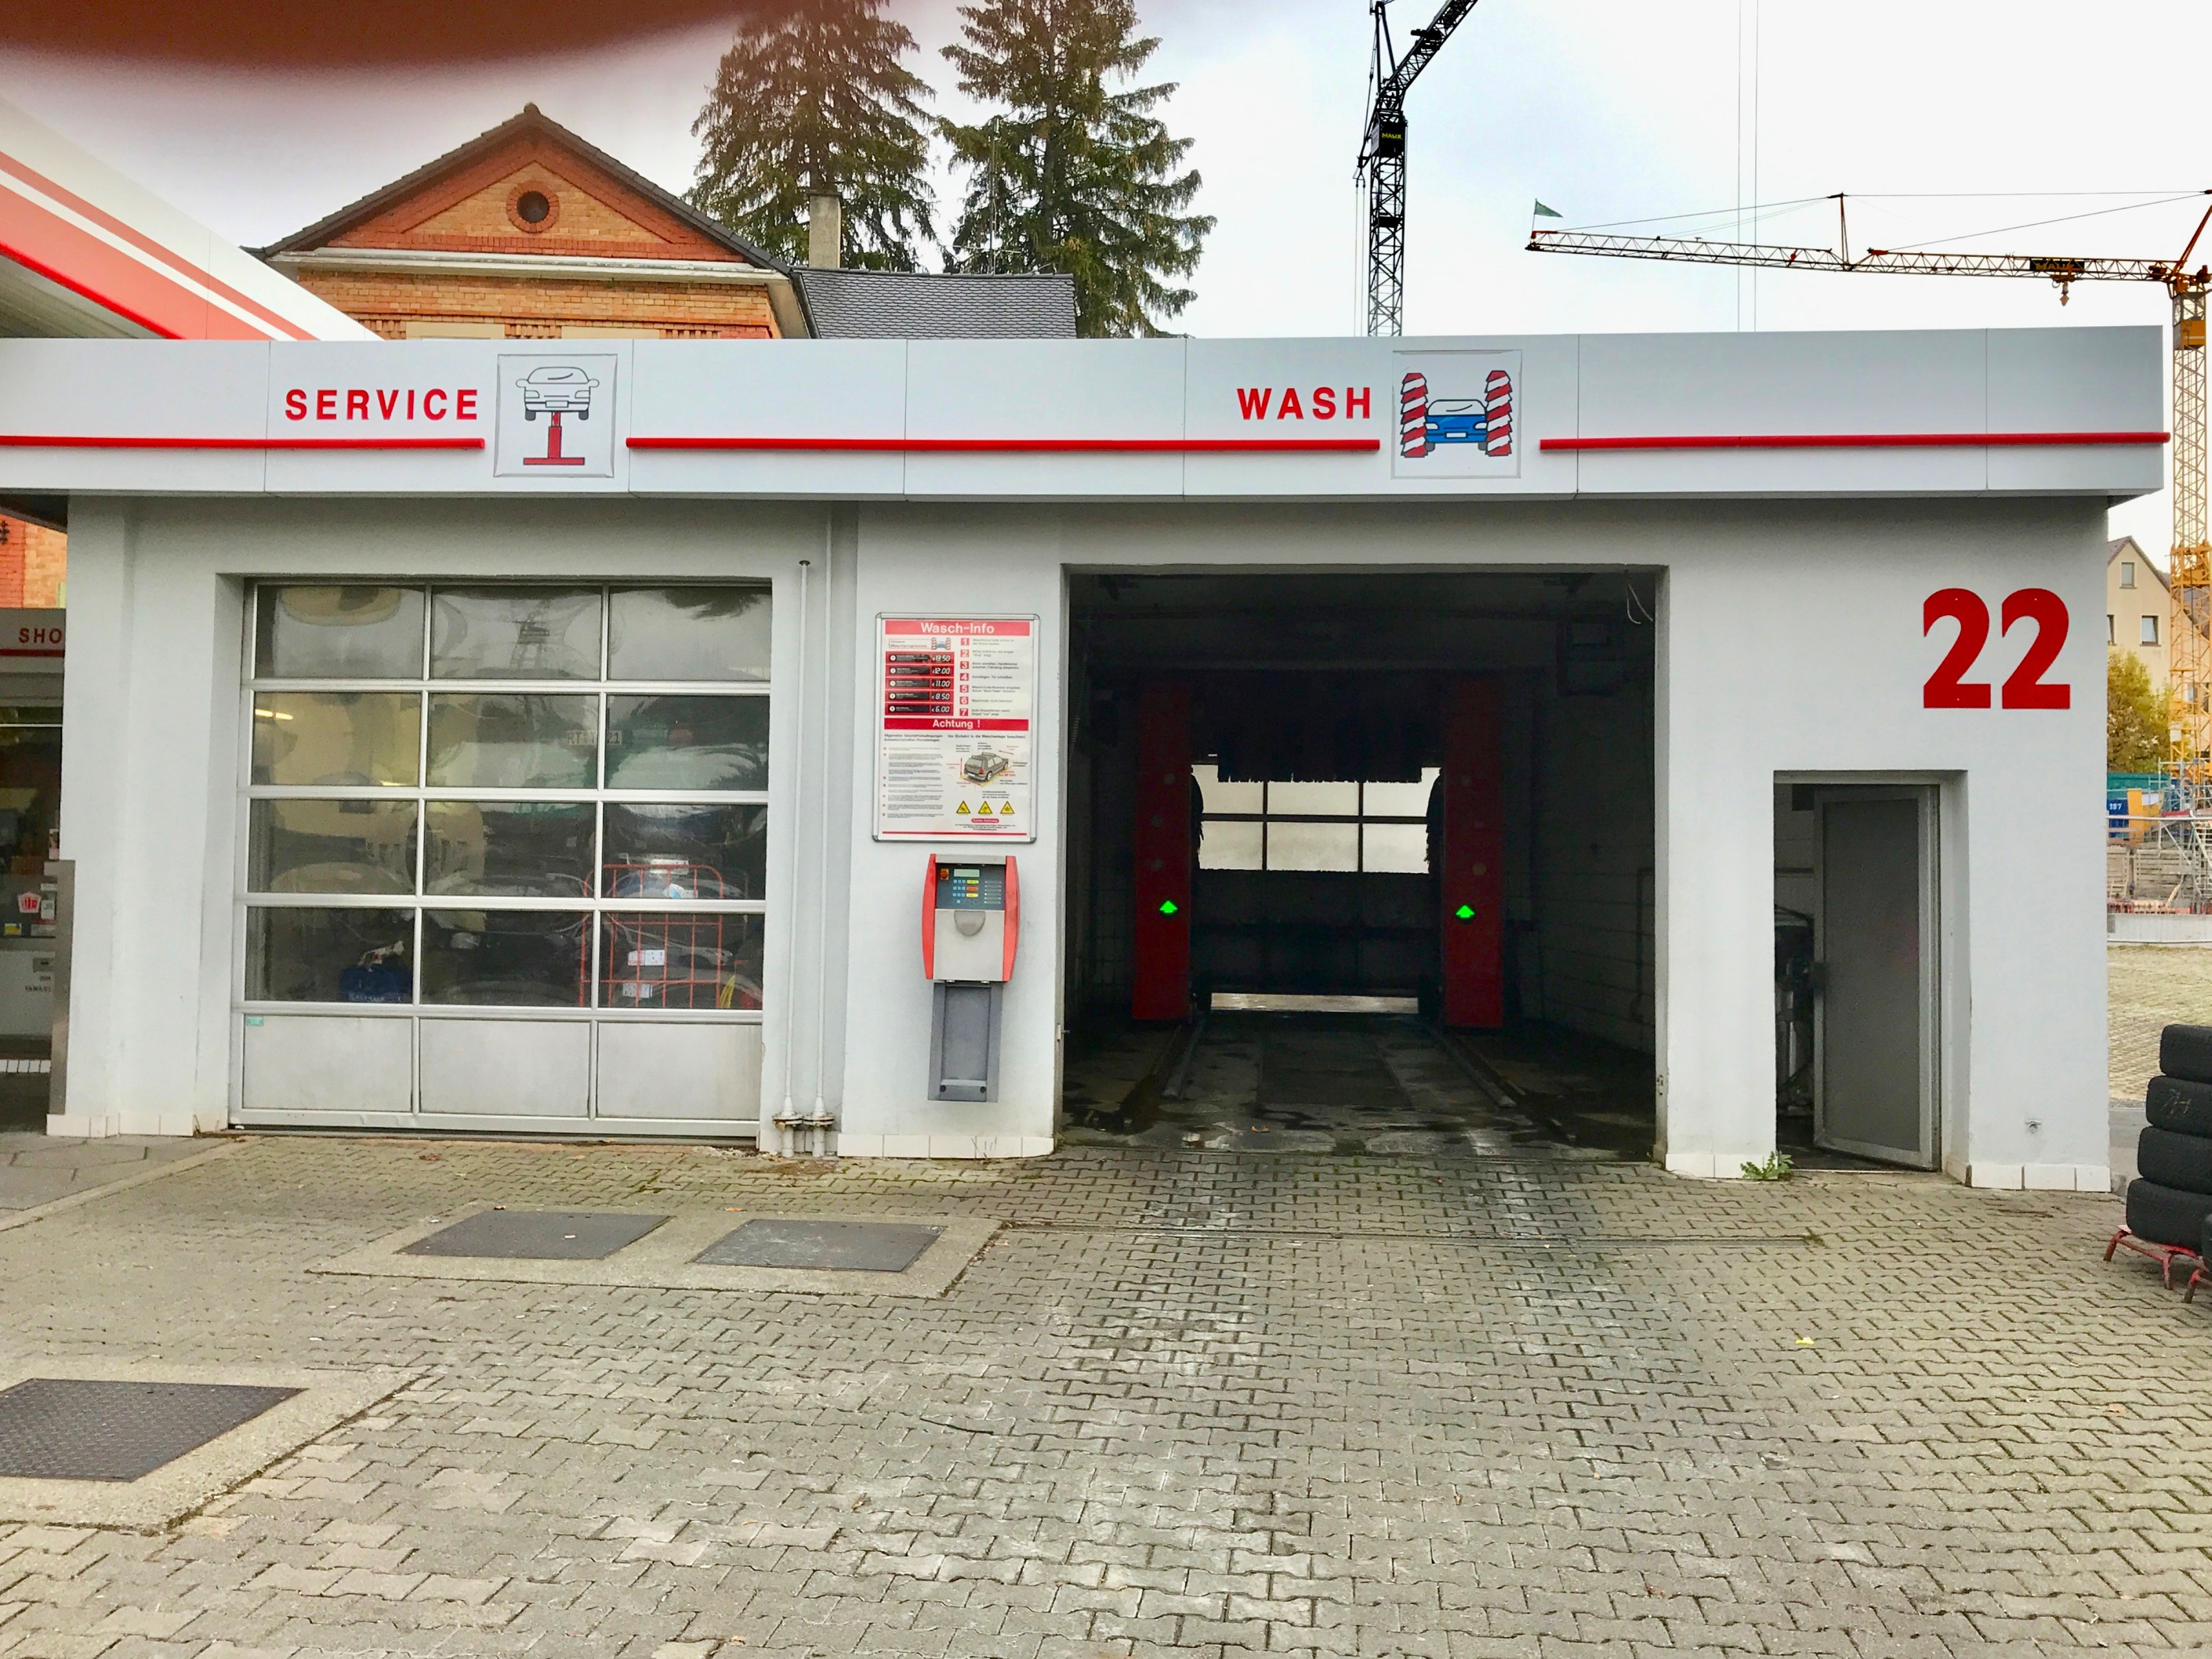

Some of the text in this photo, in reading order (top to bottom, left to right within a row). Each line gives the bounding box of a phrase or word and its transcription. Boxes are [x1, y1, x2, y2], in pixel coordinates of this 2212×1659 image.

[285, 389, 478, 422] SERVICE
[1236, 386, 1371, 420] WASH
[18, 628, 63, 644] SHO
[920, 622, 995, 634] Wasch-Info
[1923, 588, 2071, 710] 22
[932, 719, 974, 730] Achtung
